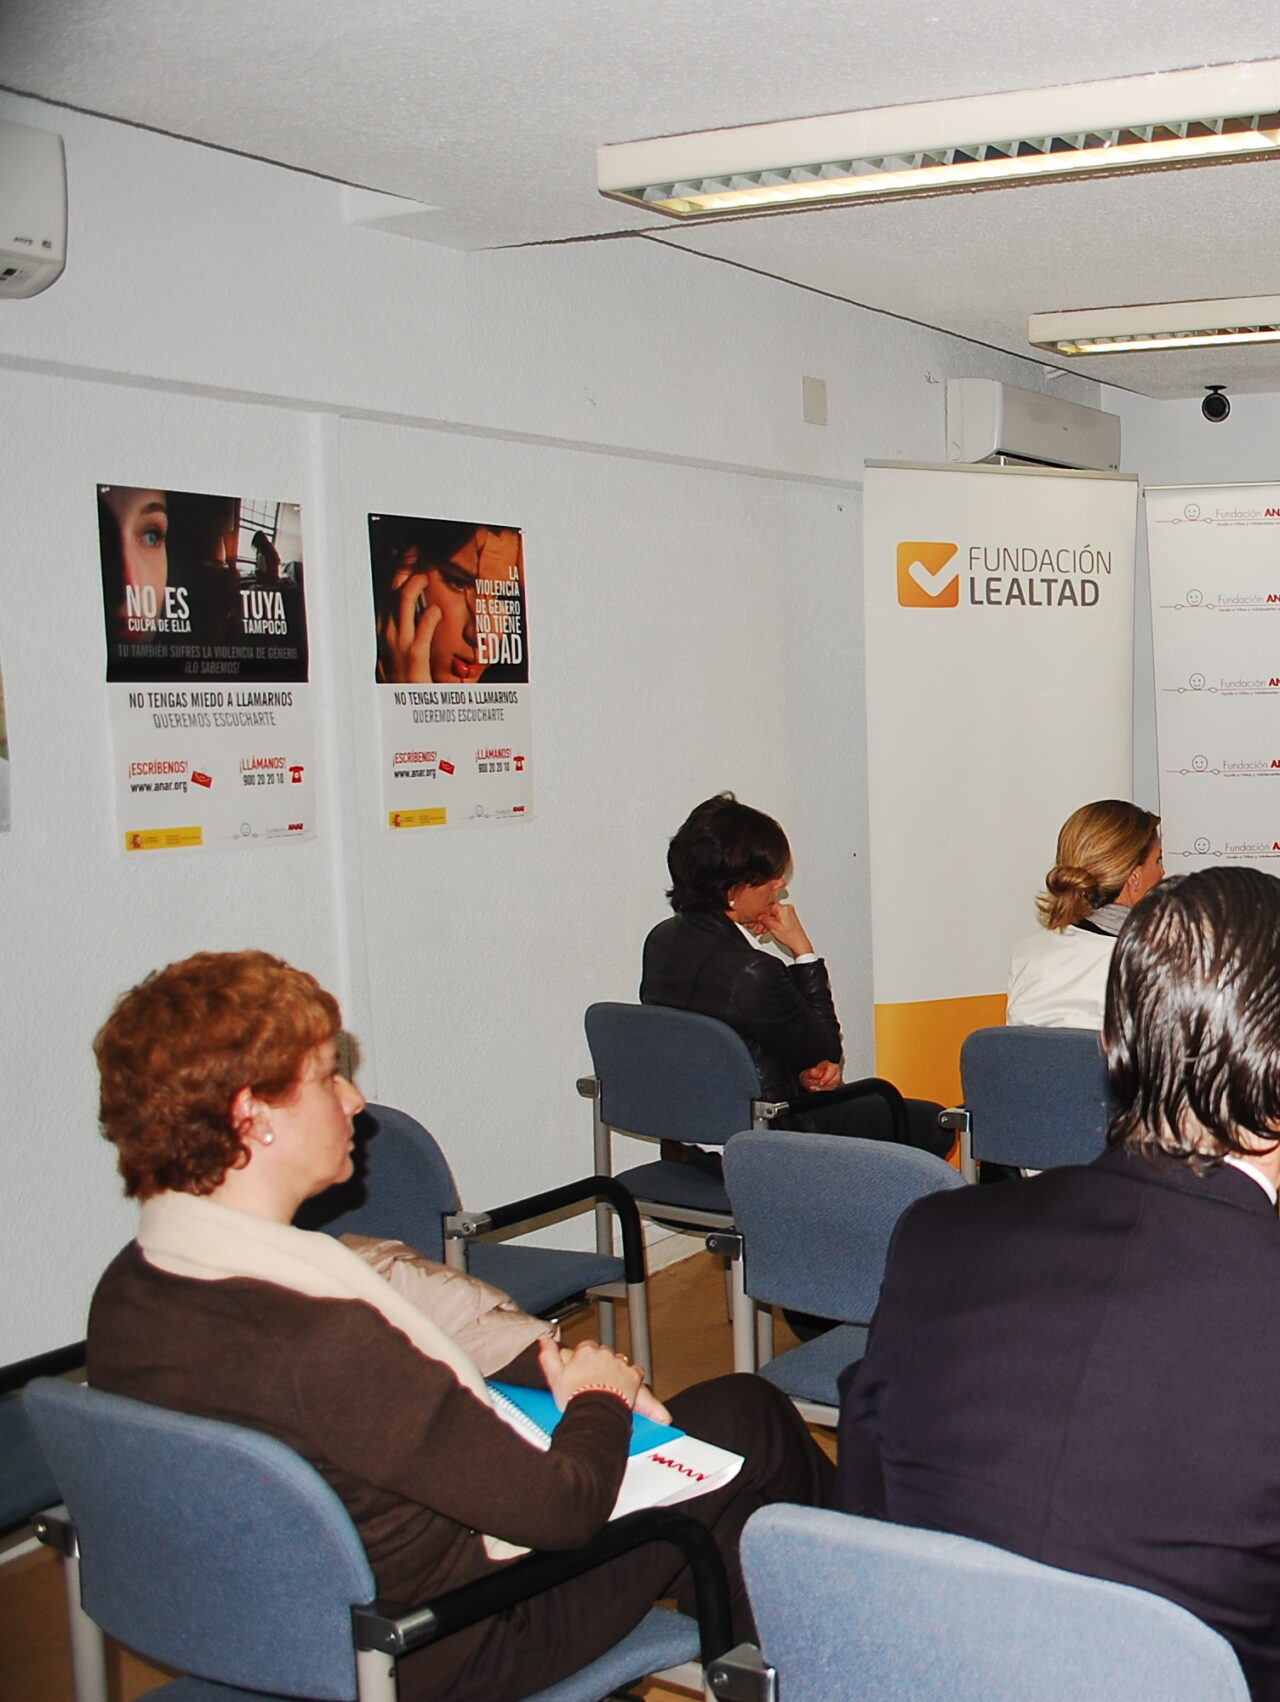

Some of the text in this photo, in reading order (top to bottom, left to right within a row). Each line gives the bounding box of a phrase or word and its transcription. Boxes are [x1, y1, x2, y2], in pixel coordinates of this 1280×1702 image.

[969, 544, 1112, 574] FUNDACIÓN
[509, 565, 519, 580] LA
[475, 579, 520, 597] VIOLENCIA
[970, 577, 1099, 607] LEALTAD
[126, 584, 190, 619] NO ES
[240, 590, 285, 620] TUYA
[475, 595, 520, 615] DE GÉNERO
[128, 619, 191, 632] CULPA DE ELLA
[243, 619, 287, 635] TAMPOCO
[476, 615, 522, 634] NO TIENE
[131, 642, 168, 658] TAMBIÉN
[170, 645, 201, 658] SUFRES
[202, 646, 212, 659] LA
[213, 646, 254, 659] VIOLENCIA
[256, 646, 266, 659] DE
[476, 633, 523, 664] EDAD
[129, 692, 293, 708] NO TENGAS MIEDO A LLAMARNOS
[394, 691, 518, 705] NO TENGAS MIEDO A LLAMARNOS
[152, 711, 276, 729] QUEREMOS ESCUCHARTE
[413, 708, 505, 723] QUEREMOS ESCUCHARTE
[128, 760, 188, 779] ¡ESCRÍBENOS!
[130, 781, 188, 793] www.anar.org
